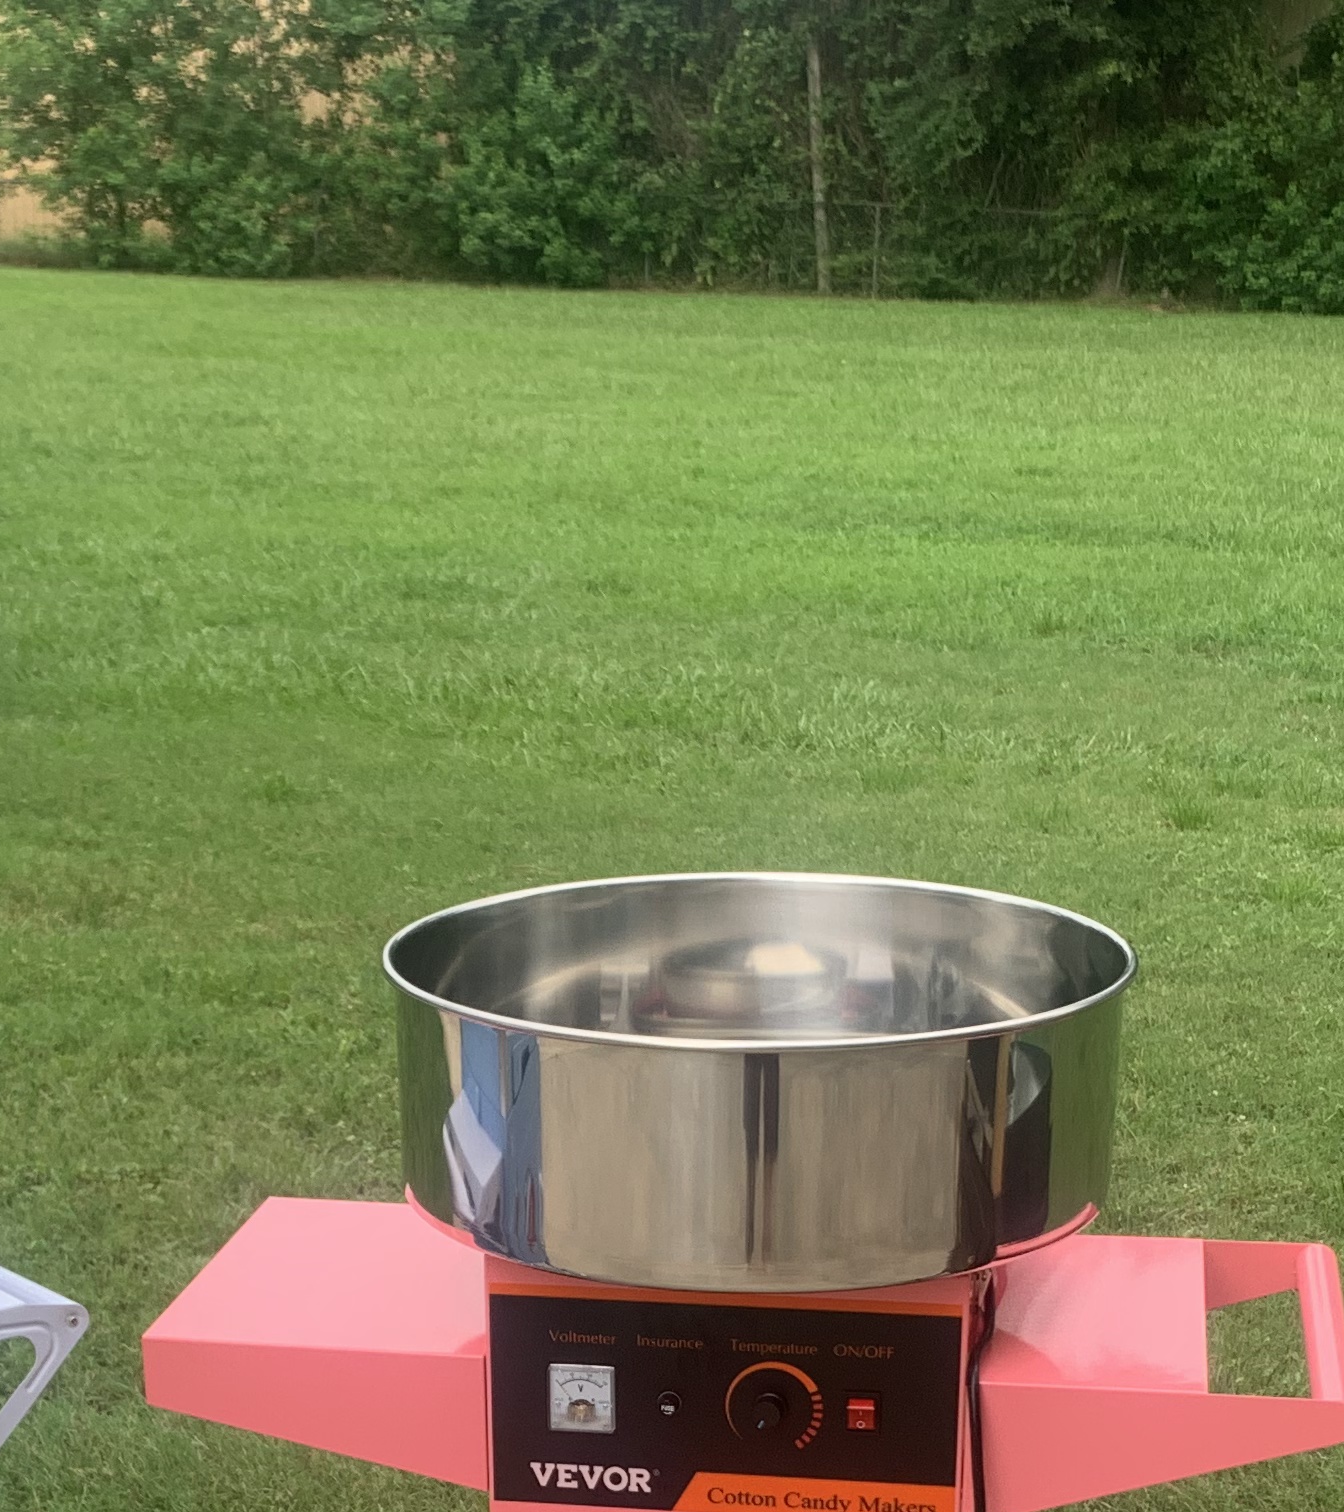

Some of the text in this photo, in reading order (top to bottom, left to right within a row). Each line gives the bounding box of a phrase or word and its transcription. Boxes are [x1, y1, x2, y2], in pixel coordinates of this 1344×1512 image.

[548, 1329, 616, 1346] Voltmeter
[636, 1333, 704, 1350] Insurance
[729, 1338, 818, 1357] Temperature
[833, 1343, 896, 1360] ON/OFF
[577, 1383, 584, 1393] V
[706, 1486, 777, 1508] Cotton
